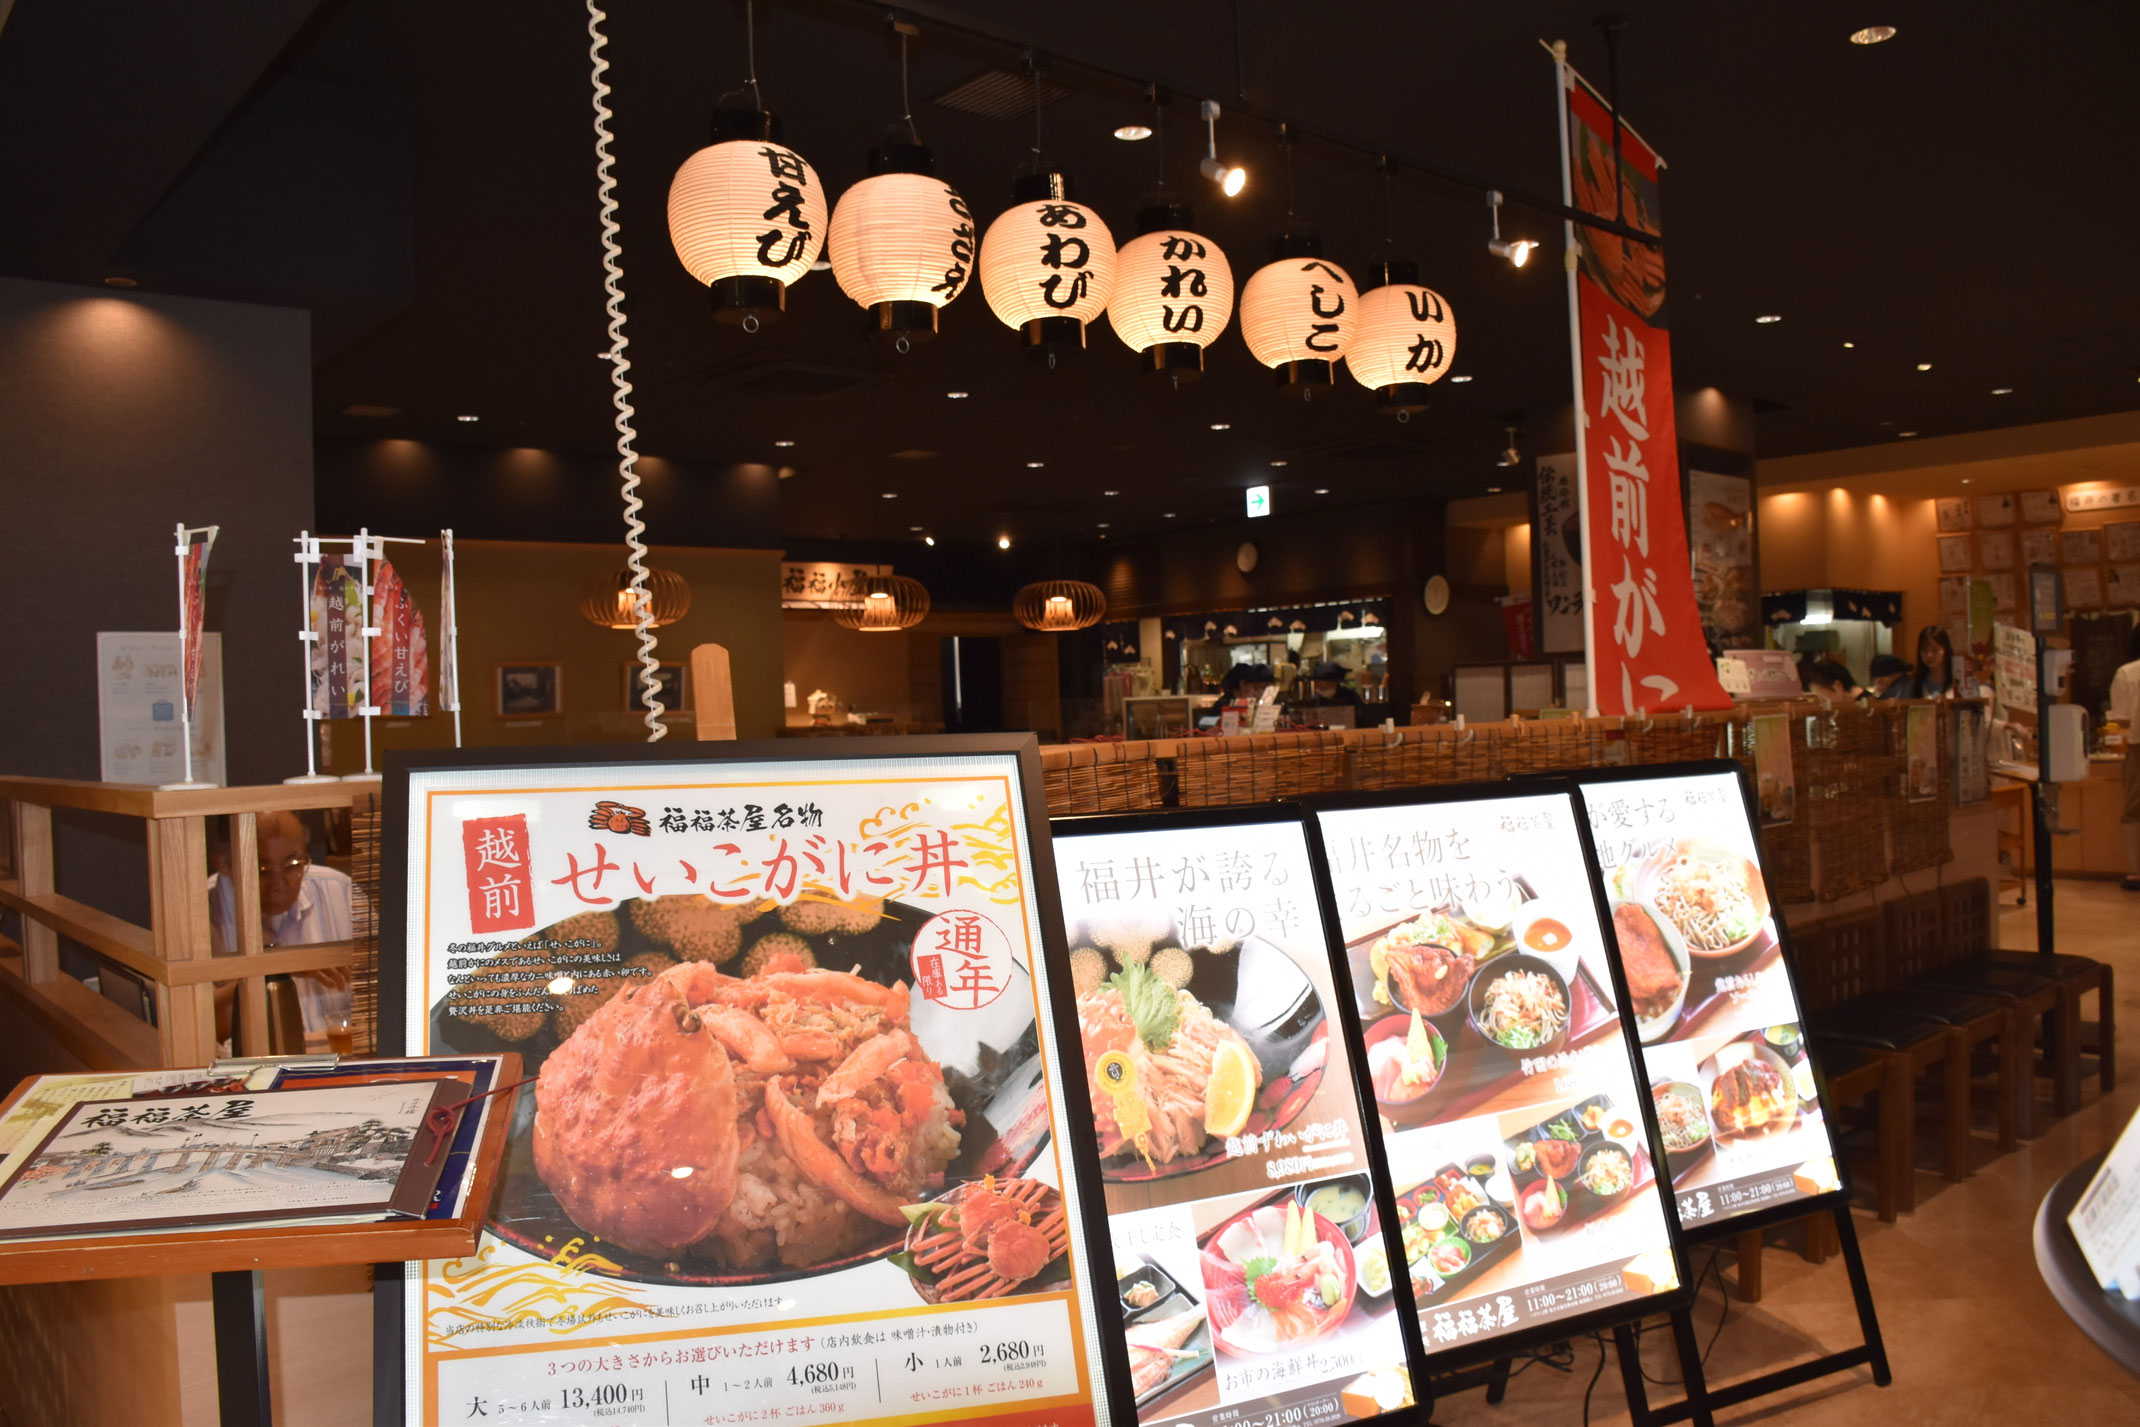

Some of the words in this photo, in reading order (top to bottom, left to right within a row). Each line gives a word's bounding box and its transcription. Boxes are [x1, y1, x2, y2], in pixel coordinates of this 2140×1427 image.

[758, 146, 811, 268] 甘えび
[1037, 203, 1092, 308] あわび
[1160, 235, 1207, 334] かれい
[1301, 259, 1345, 353] へしこ
[1406, 290, 1444, 374] いか
[1597, 313, 1680, 716] 越前がに
[328, 595, 346, 697] 越前がれい
[394, 596, 410, 695] ふくい甘えび
[658, 801, 824, 834] 福福茶屋名物
[474, 826, 523, 919] 越前
[550, 828, 971, 906] せいこがに丼
[1076, 849, 1290, 905] 福井が誇る
[1341, 868, 1514, 918] るごと味わう
[1179, 896, 1301, 947] 海の幸
[934, 915, 1000, 1009] 通年
[80, 1099, 256, 1129] 福福茶屋
[1678, 1190, 1716, 1223] 茶屋
[1432, 1294, 1520, 1344] 福福茶屋
[547, 1335, 816, 1377] 3つの大きさからお選びいただけます
[690, 1374, 711, 1396] 中
[786, 1360, 855, 1387] 4,680円
[904, 1351, 924, 1373] 小
[980, 1339, 1045, 1365] 2,680円
[466, 1395, 489, 1419] 大
[560, 1382, 644, 1410] 13,400円
